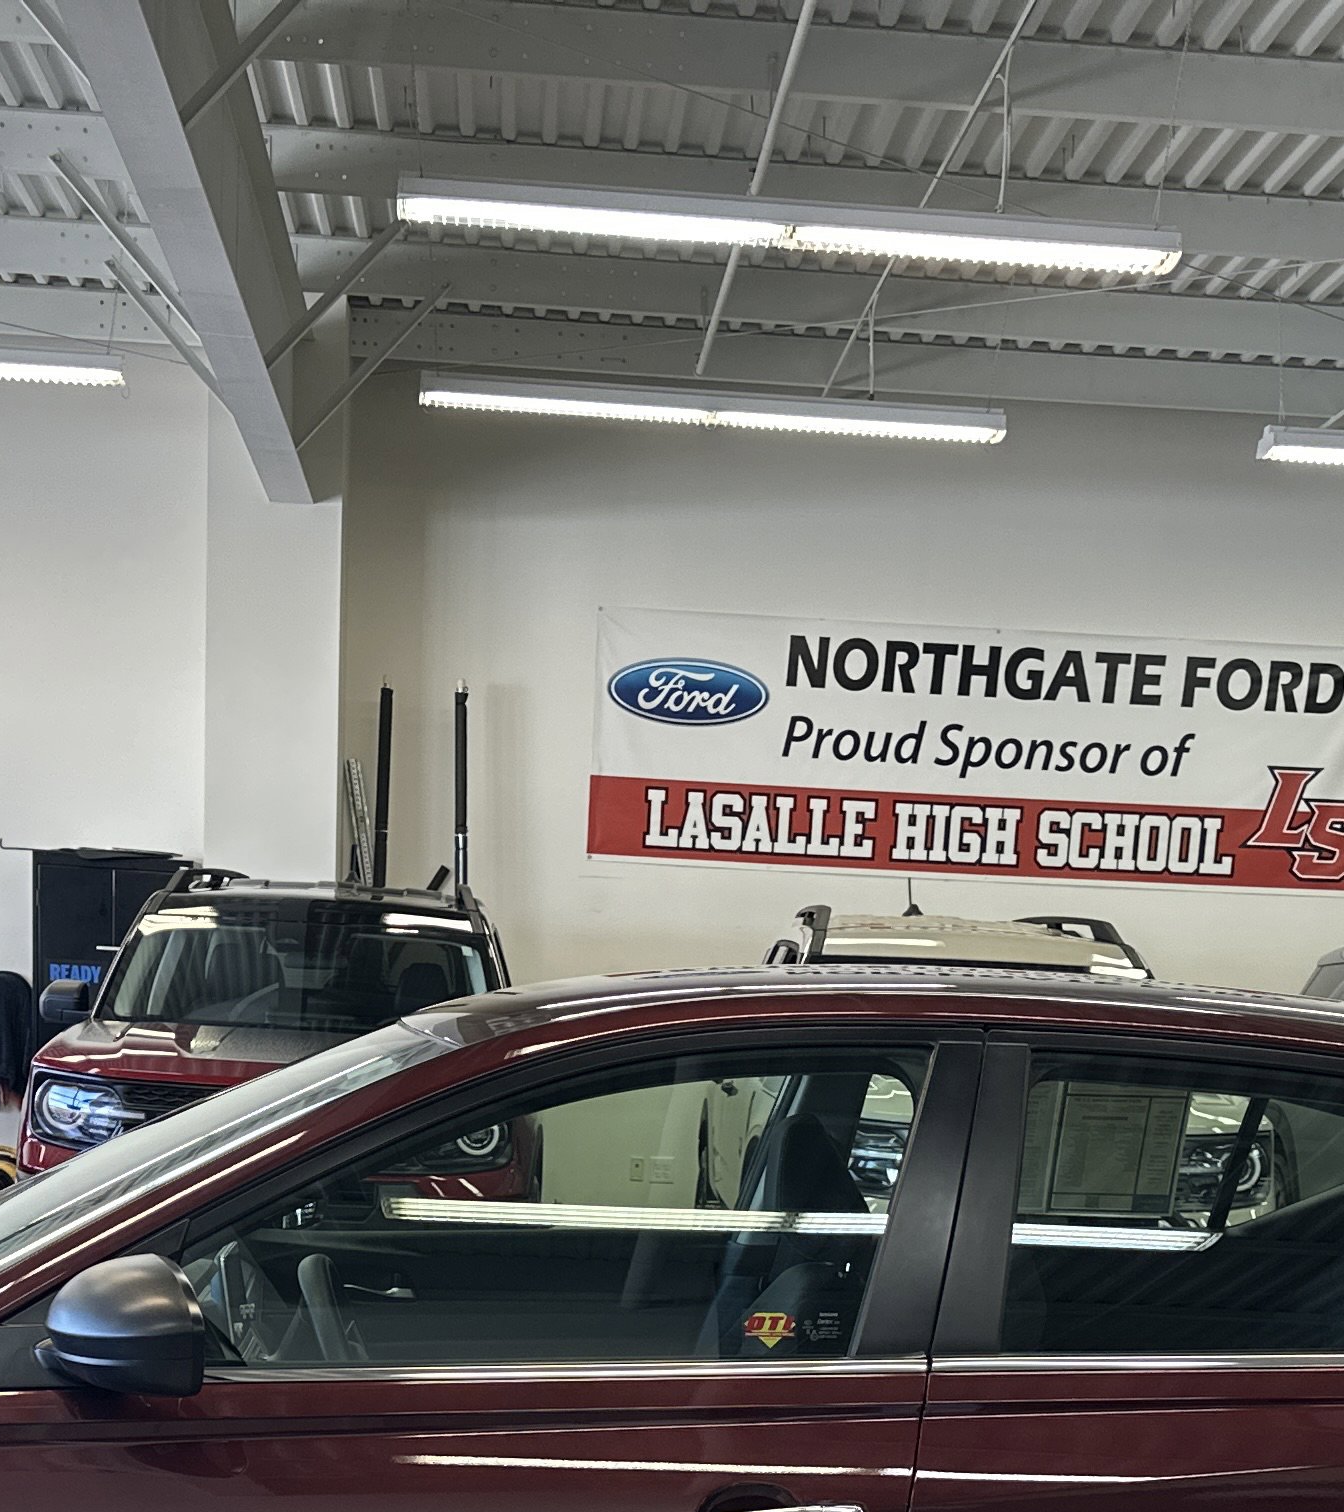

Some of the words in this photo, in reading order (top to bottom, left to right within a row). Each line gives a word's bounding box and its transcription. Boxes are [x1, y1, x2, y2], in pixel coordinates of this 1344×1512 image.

[636, 667, 742, 716] Ford
[785, 634, 1167, 706] NORTHGATE
[781, 715, 928, 765] Proud
[933, 723, 1132, 779] Sponsor
[1140, 733, 1196, 777] of
[643, 787, 877, 860] LASALLE
[891, 801, 1022, 867] HIGH
[1035, 809, 1235, 877] SCHOOL
[49, 963, 102, 984] READY
